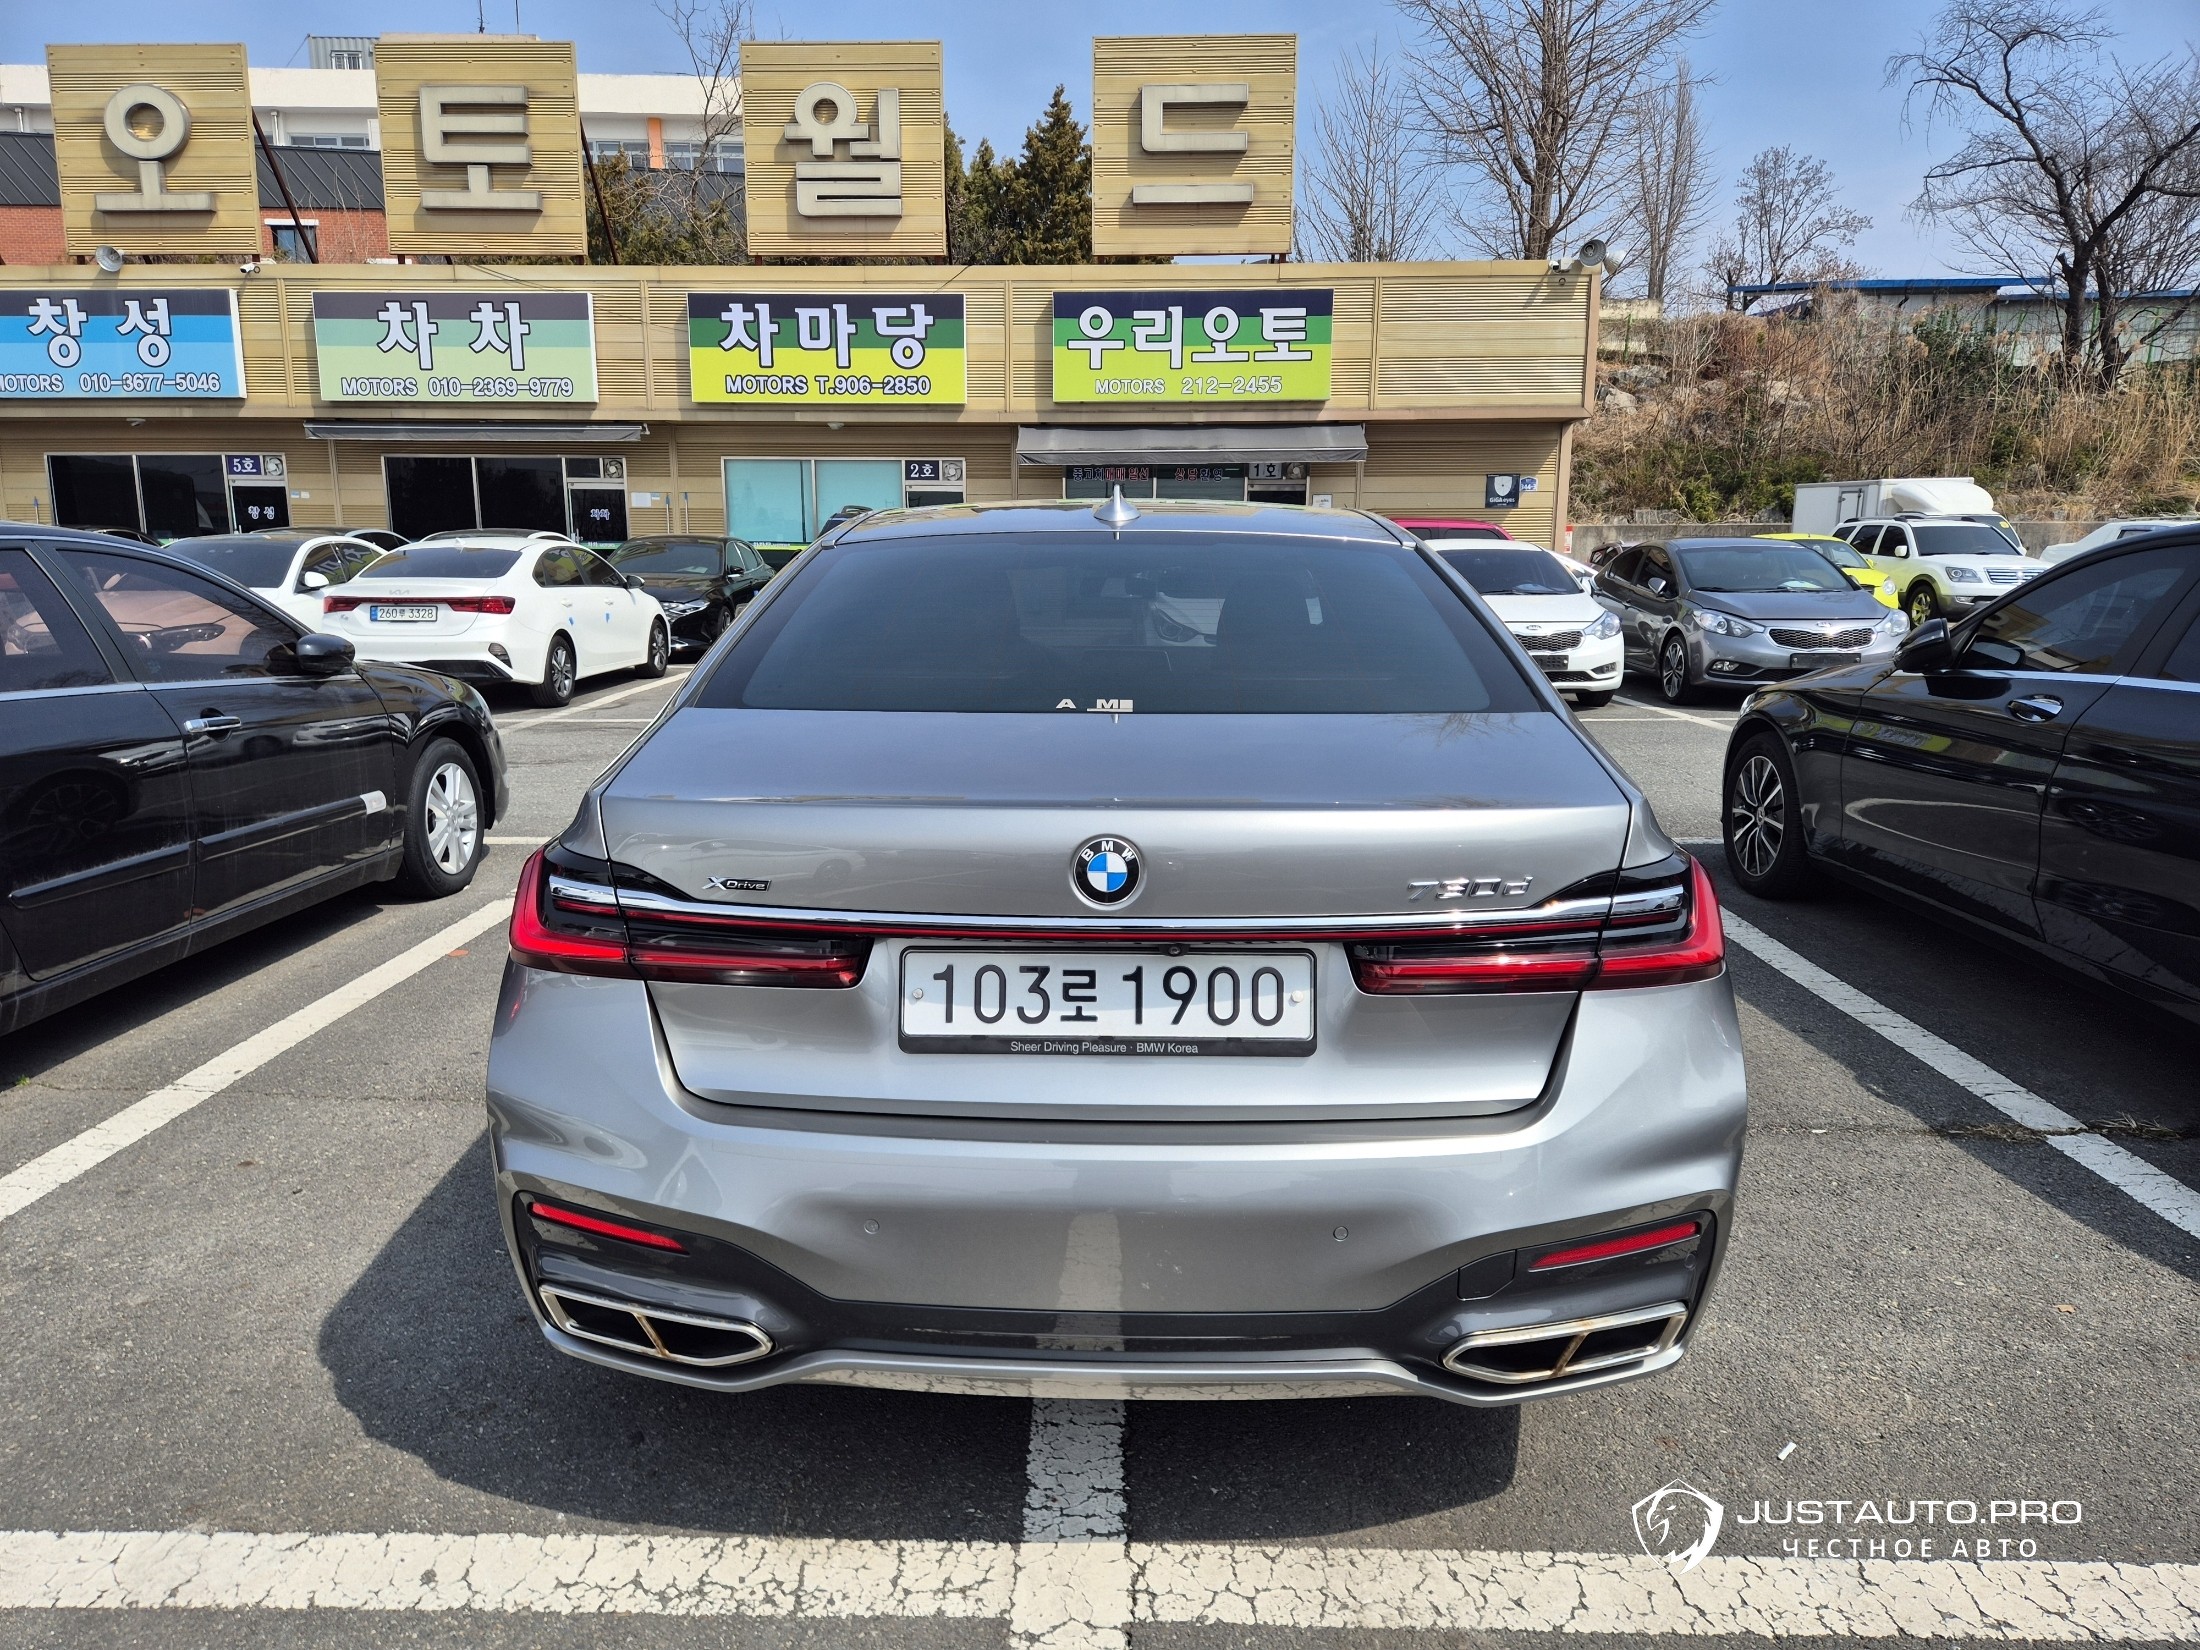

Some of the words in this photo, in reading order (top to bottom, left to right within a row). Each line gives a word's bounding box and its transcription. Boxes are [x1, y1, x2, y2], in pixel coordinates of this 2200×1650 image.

[27, 298, 172, 368] 창성
[376, 301, 531, 371] 차차
[718, 303, 936, 369] 차마당
[1067, 306, 1313, 370] 우리오토
[79, 373, 221, 393] 010-3677-5046
[341, 377, 418, 397] MOTORS
[428, 377, 574, 397] 010-2369-9779
[725, 374, 809, 395] MOTORS
[815, 376, 931, 396] T.906-2850
[1095, 379, 1165, 394] MOTORS
[1181, 376, 1283, 395] 212-2455
[233, 458, 257, 474] 5호
[910, 463, 935, 478] 2호
[1254, 463, 1277, 478] 1호
[1080, 840, 1136, 862] BMW
[1407, 876, 1534, 900] 730d
[1010, 1041, 1041, 1052] Sheer
[1044, 1041, 1079, 1054] Driving
[1082, 1042, 1127, 1053] Pleasure
[1136, 1043, 1165, 1053] BMW
[1168, 1043, 1199, 1054] Korea
